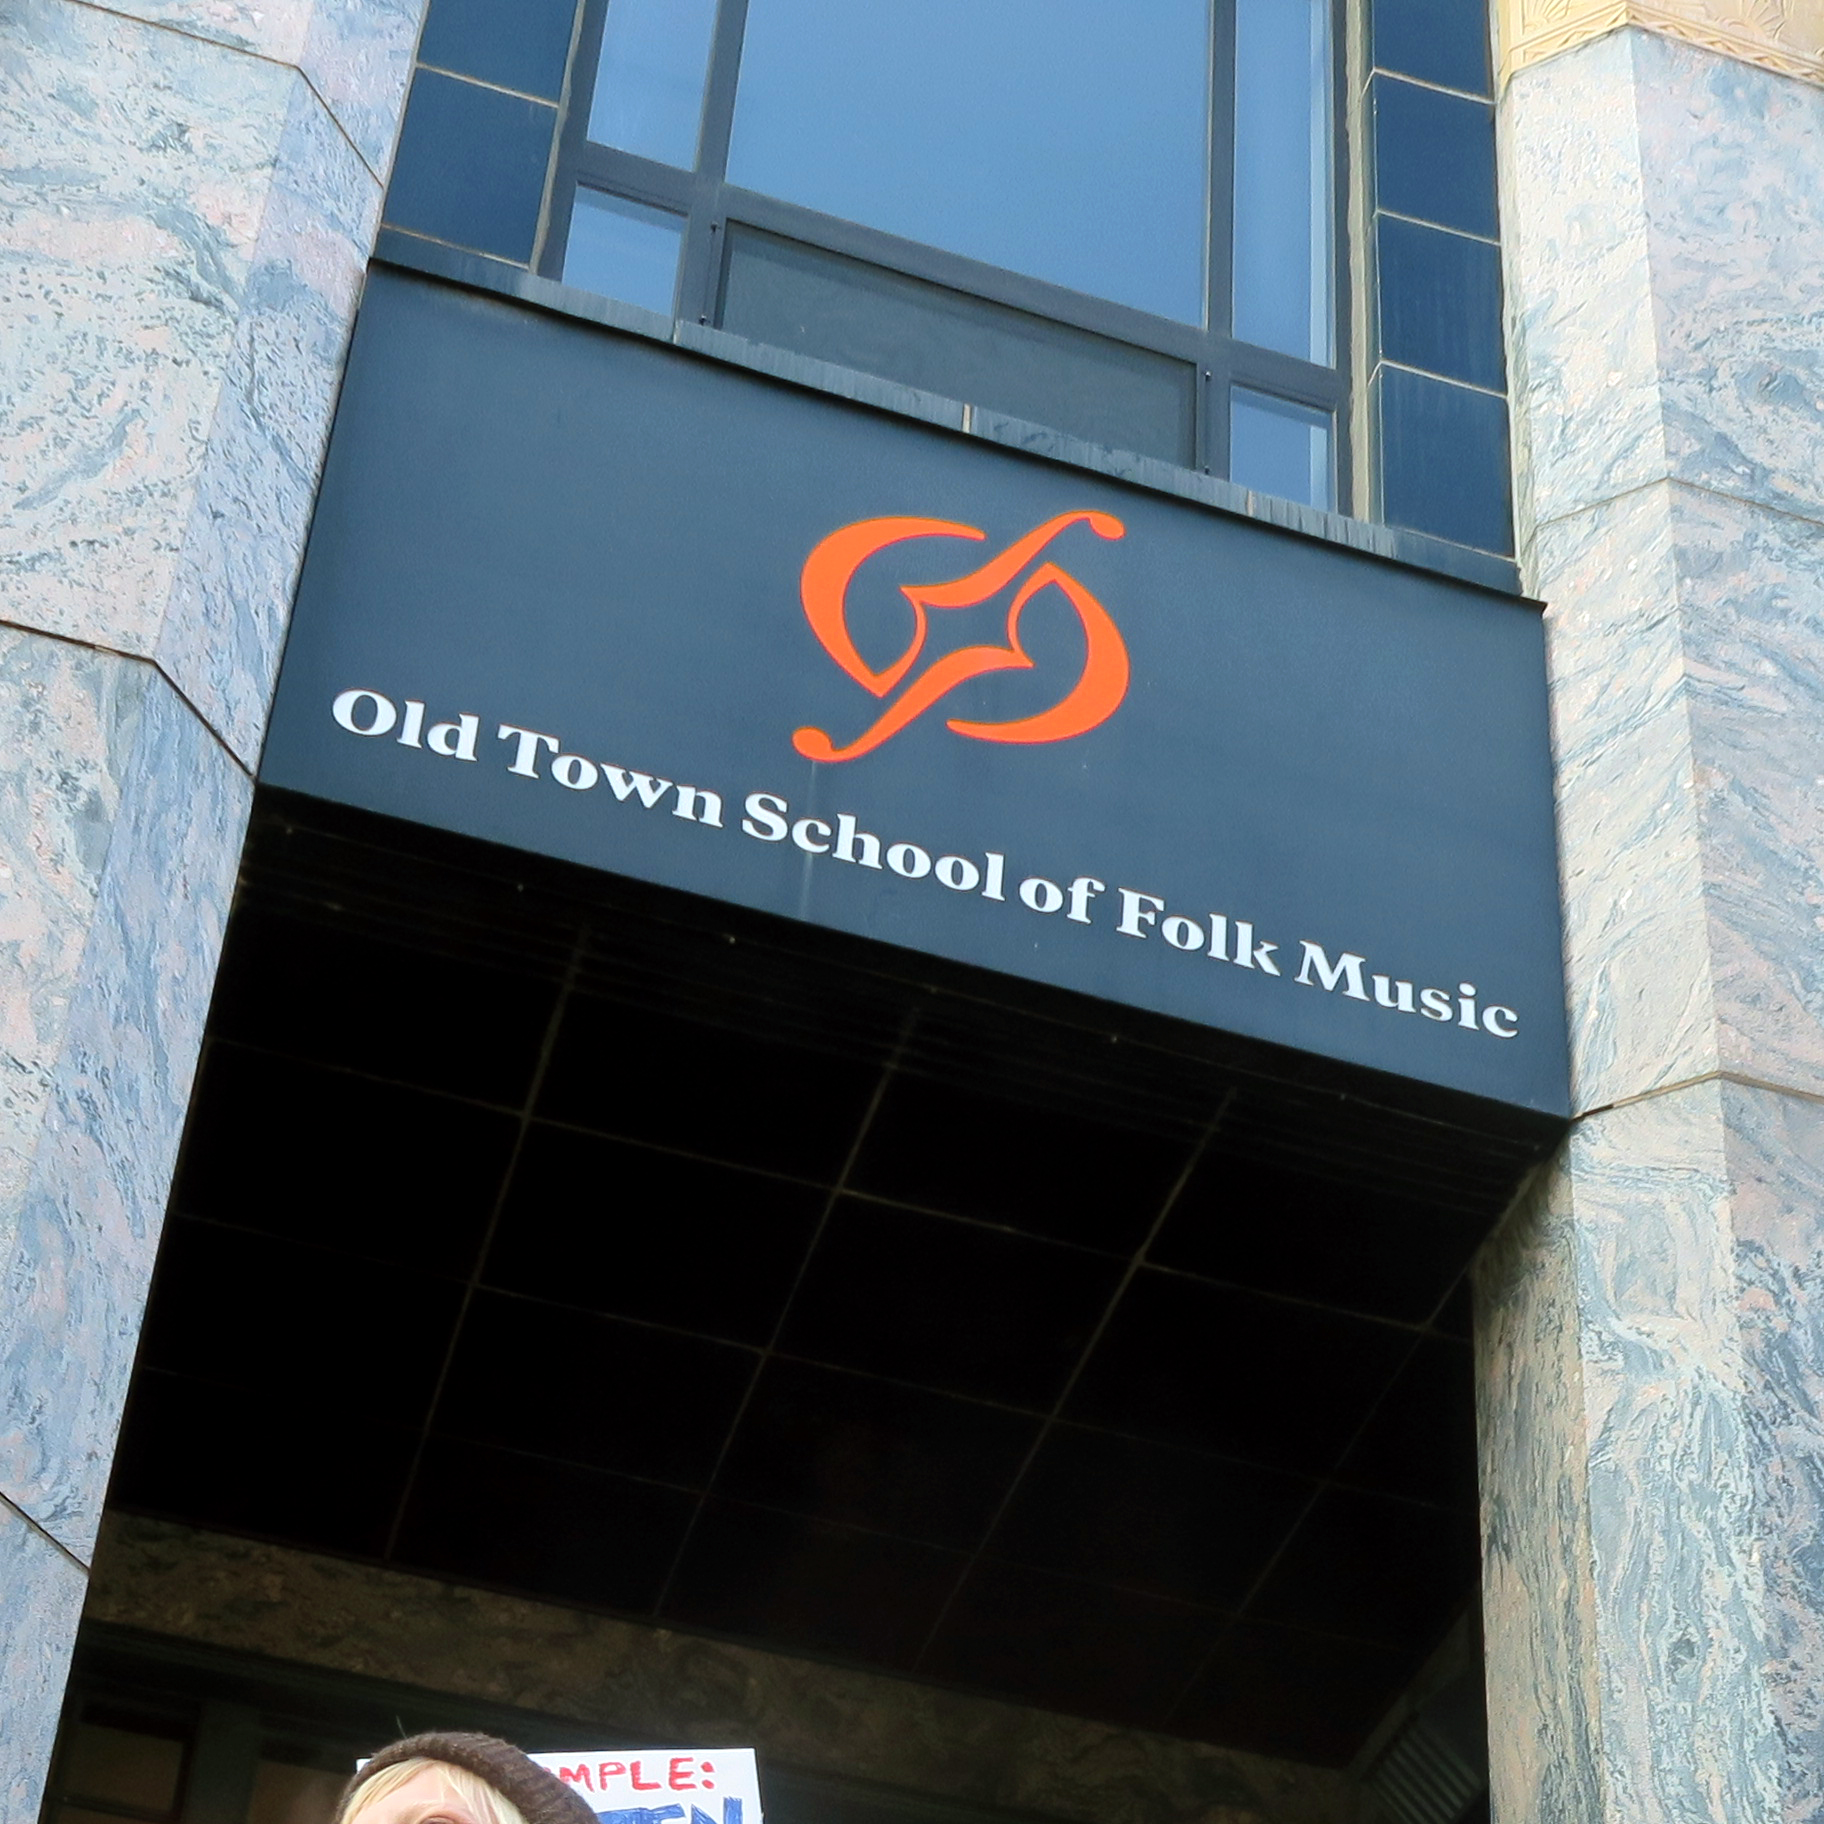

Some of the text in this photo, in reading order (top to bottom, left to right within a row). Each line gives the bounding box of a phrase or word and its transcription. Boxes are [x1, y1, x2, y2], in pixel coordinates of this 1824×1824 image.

[332, 687, 1519, 1039] Old Town School of Folk Music
[544, 1757, 715, 1793] MPLE:
